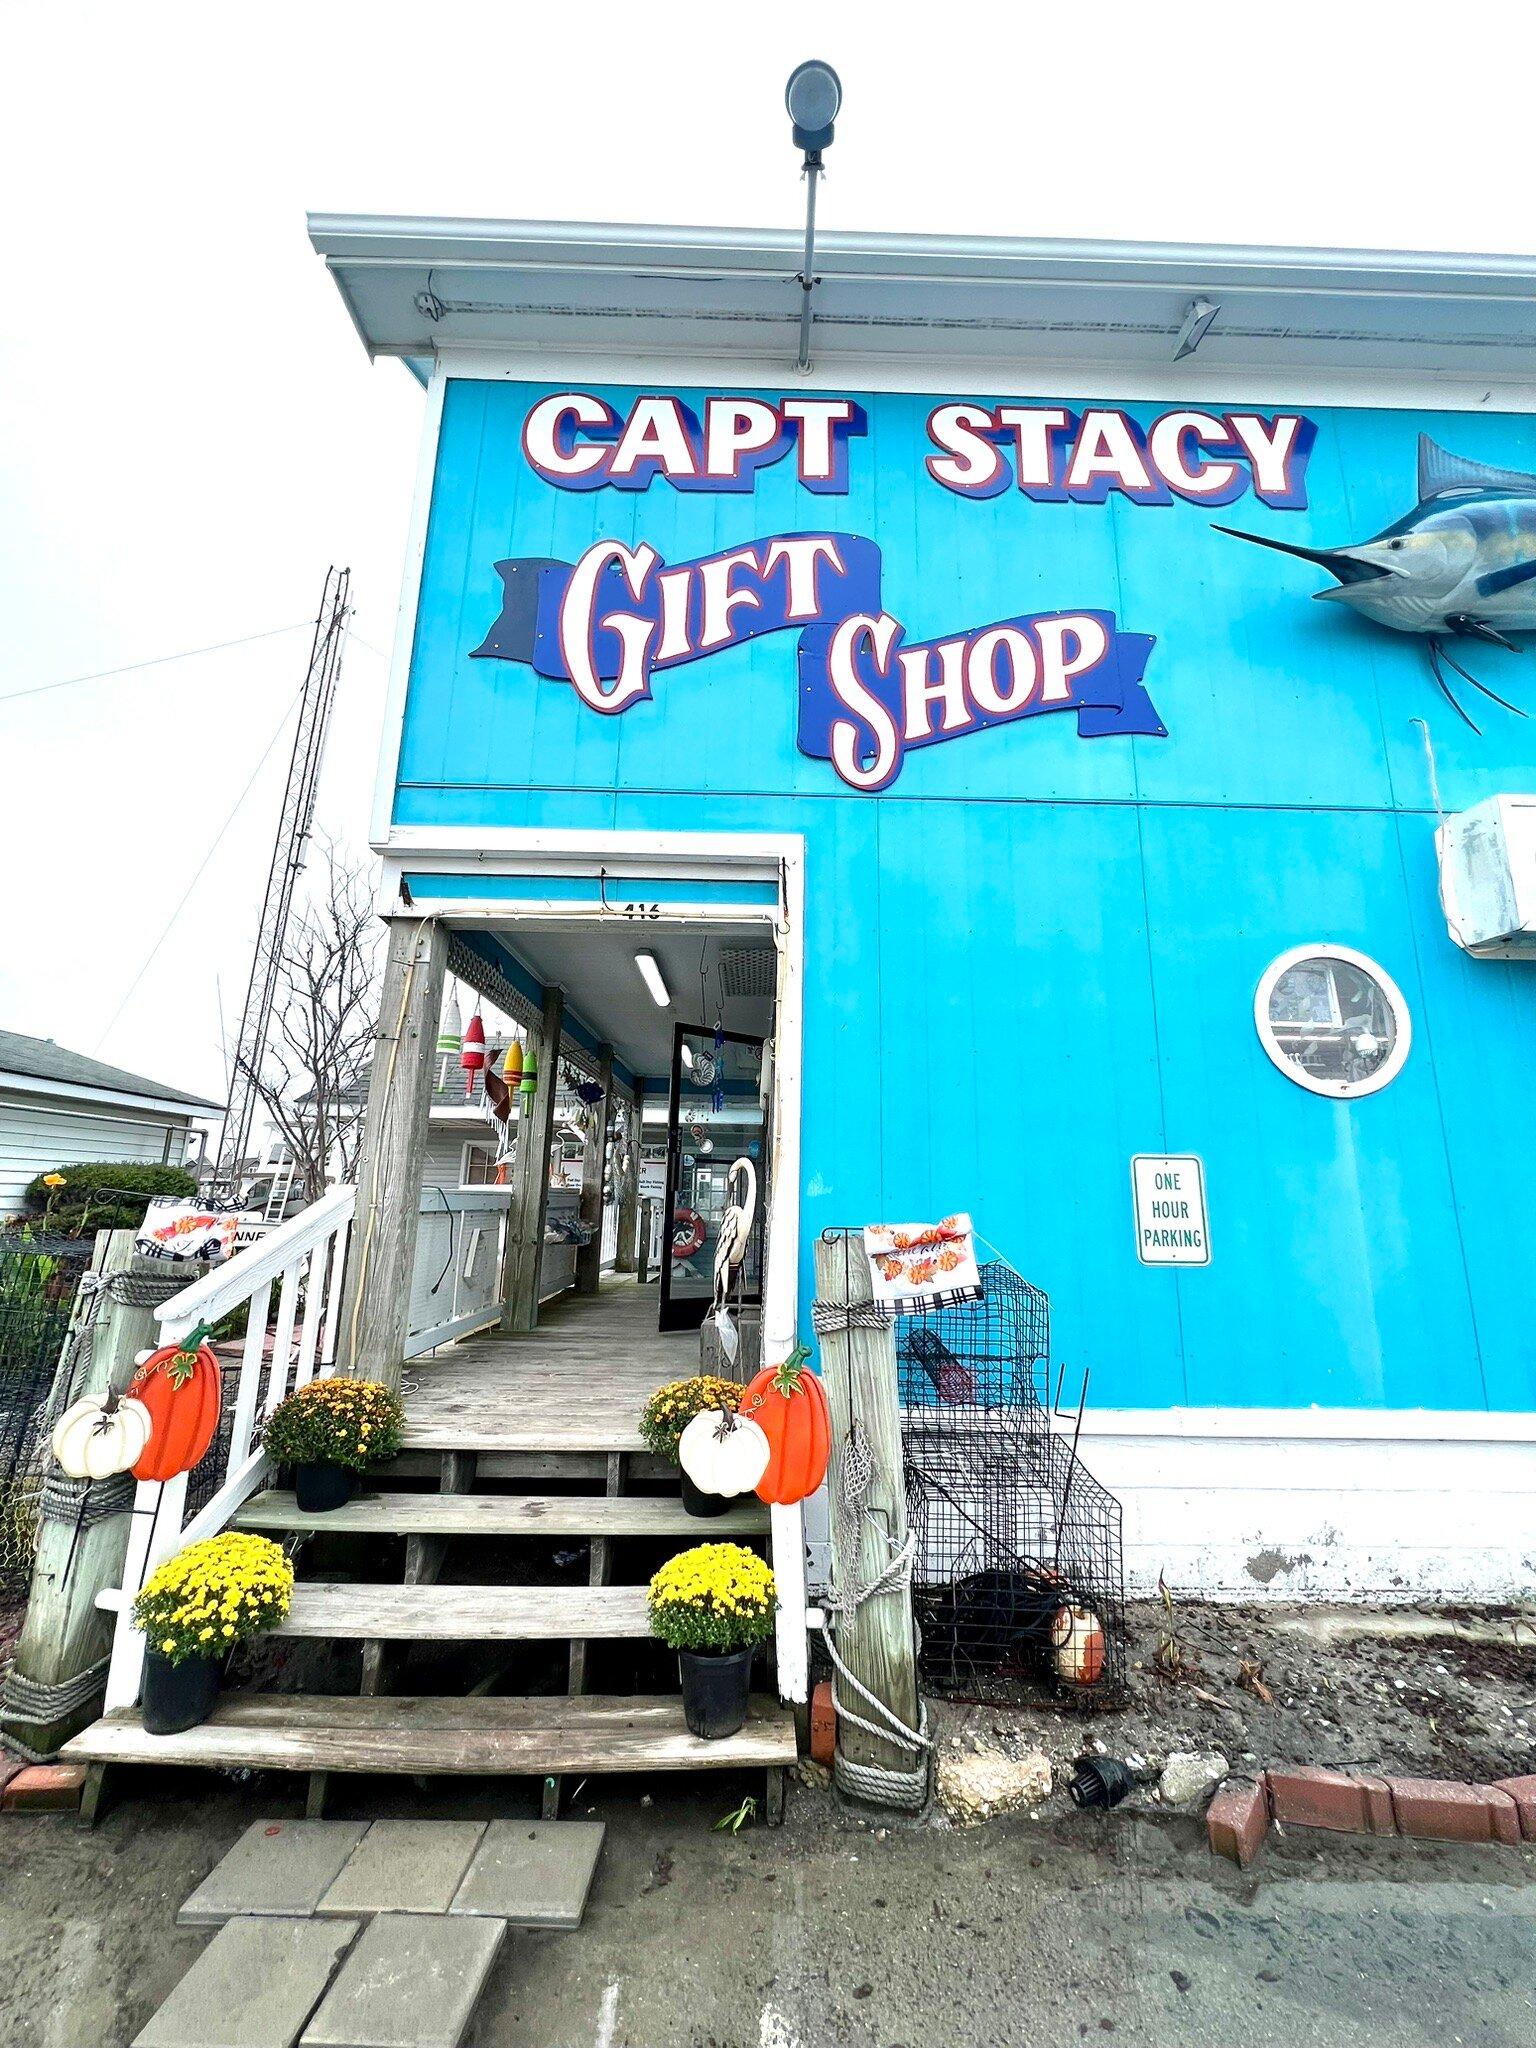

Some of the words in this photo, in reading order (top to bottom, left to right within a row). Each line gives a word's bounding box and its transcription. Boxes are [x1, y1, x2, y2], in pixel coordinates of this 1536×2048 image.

[523, 392, 860, 488] CAPT
[926, 402, 1310, 500] STACY
[558, 536, 846, 715] GIFT
[827, 610, 1109, 791] SHOP
[622, 903, 660, 919] 416
[1155, 1173, 1181, 1190] ONE
[1152, 1201, 1189, 1218] HOUR
[1144, 1229, 1201, 1247] PARKING
